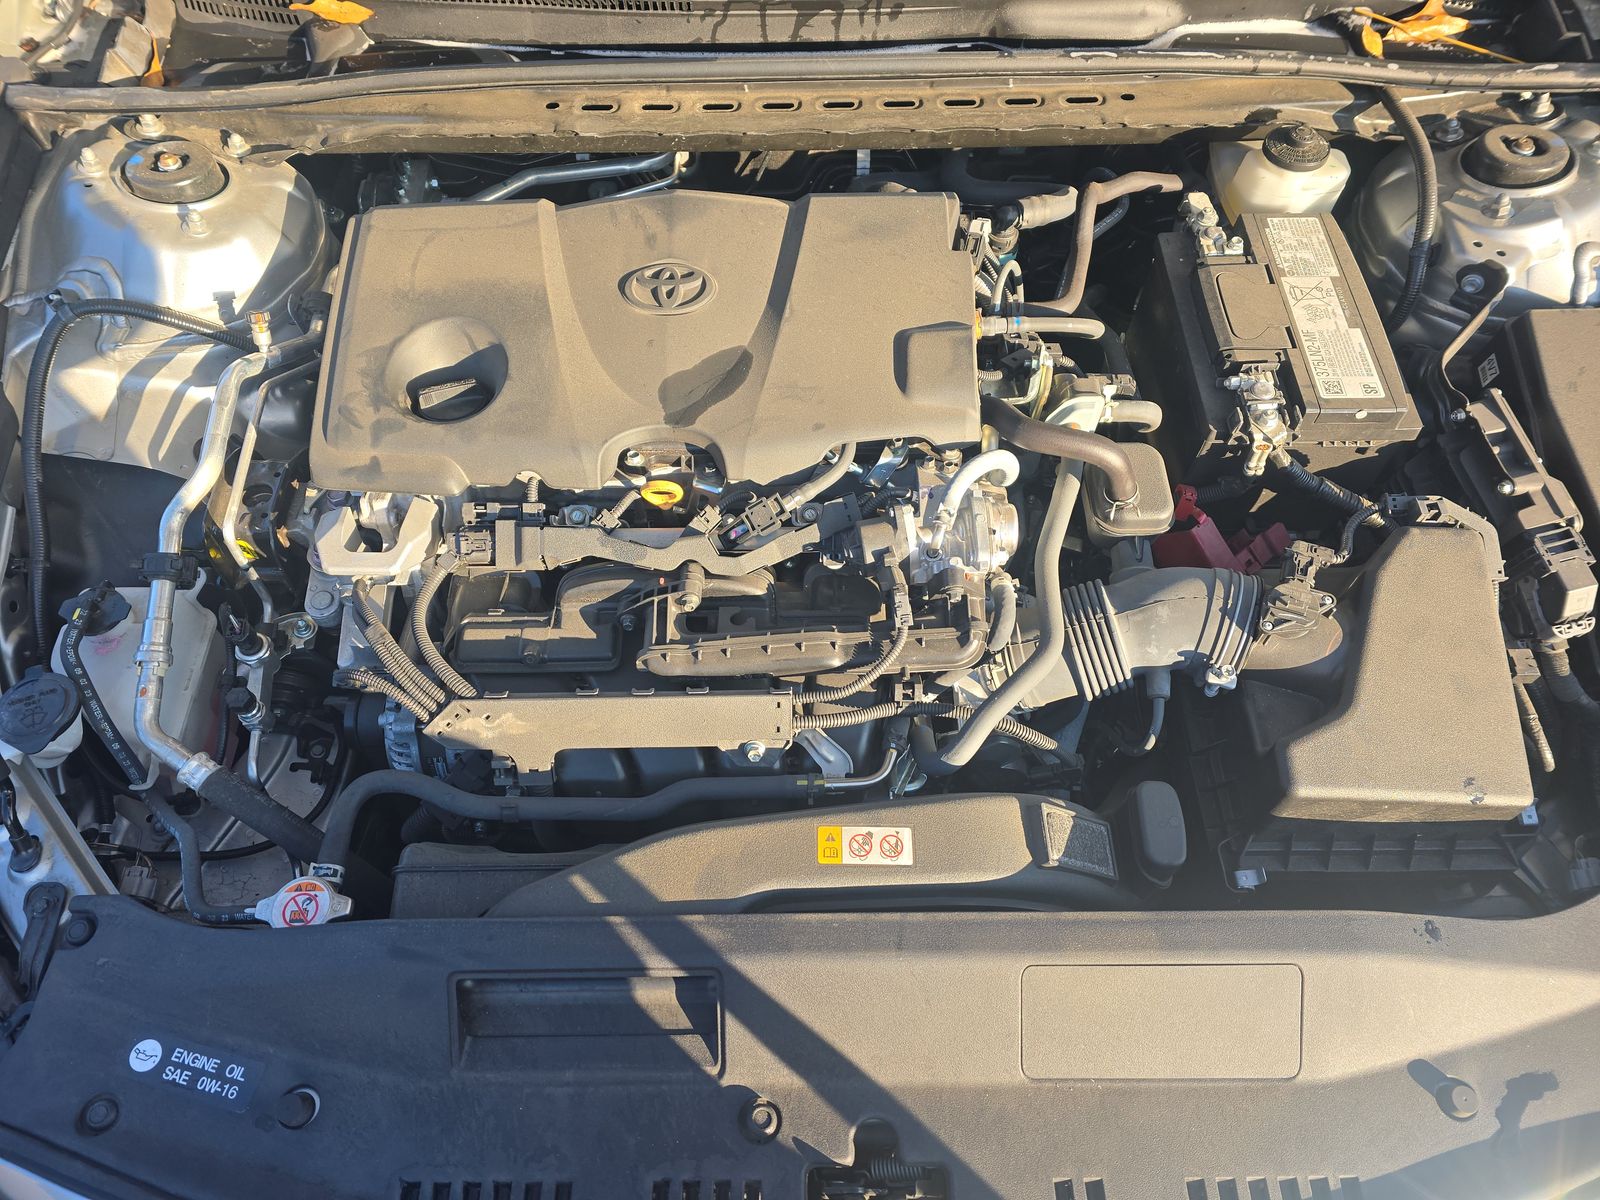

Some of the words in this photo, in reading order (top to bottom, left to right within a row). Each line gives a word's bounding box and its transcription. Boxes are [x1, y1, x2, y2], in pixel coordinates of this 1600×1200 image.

[1302, 329, 1330, 377] 375LN2-MF
[1362, 383, 1379, 395] SP
[89, 699, 104, 720] WATER
[171, 1047, 221, 1073] ENGINE
[225, 1063, 245, 1082] OIL
[162, 1065, 192, 1085] SAE
[196, 1076, 239, 1100] 0W-16
